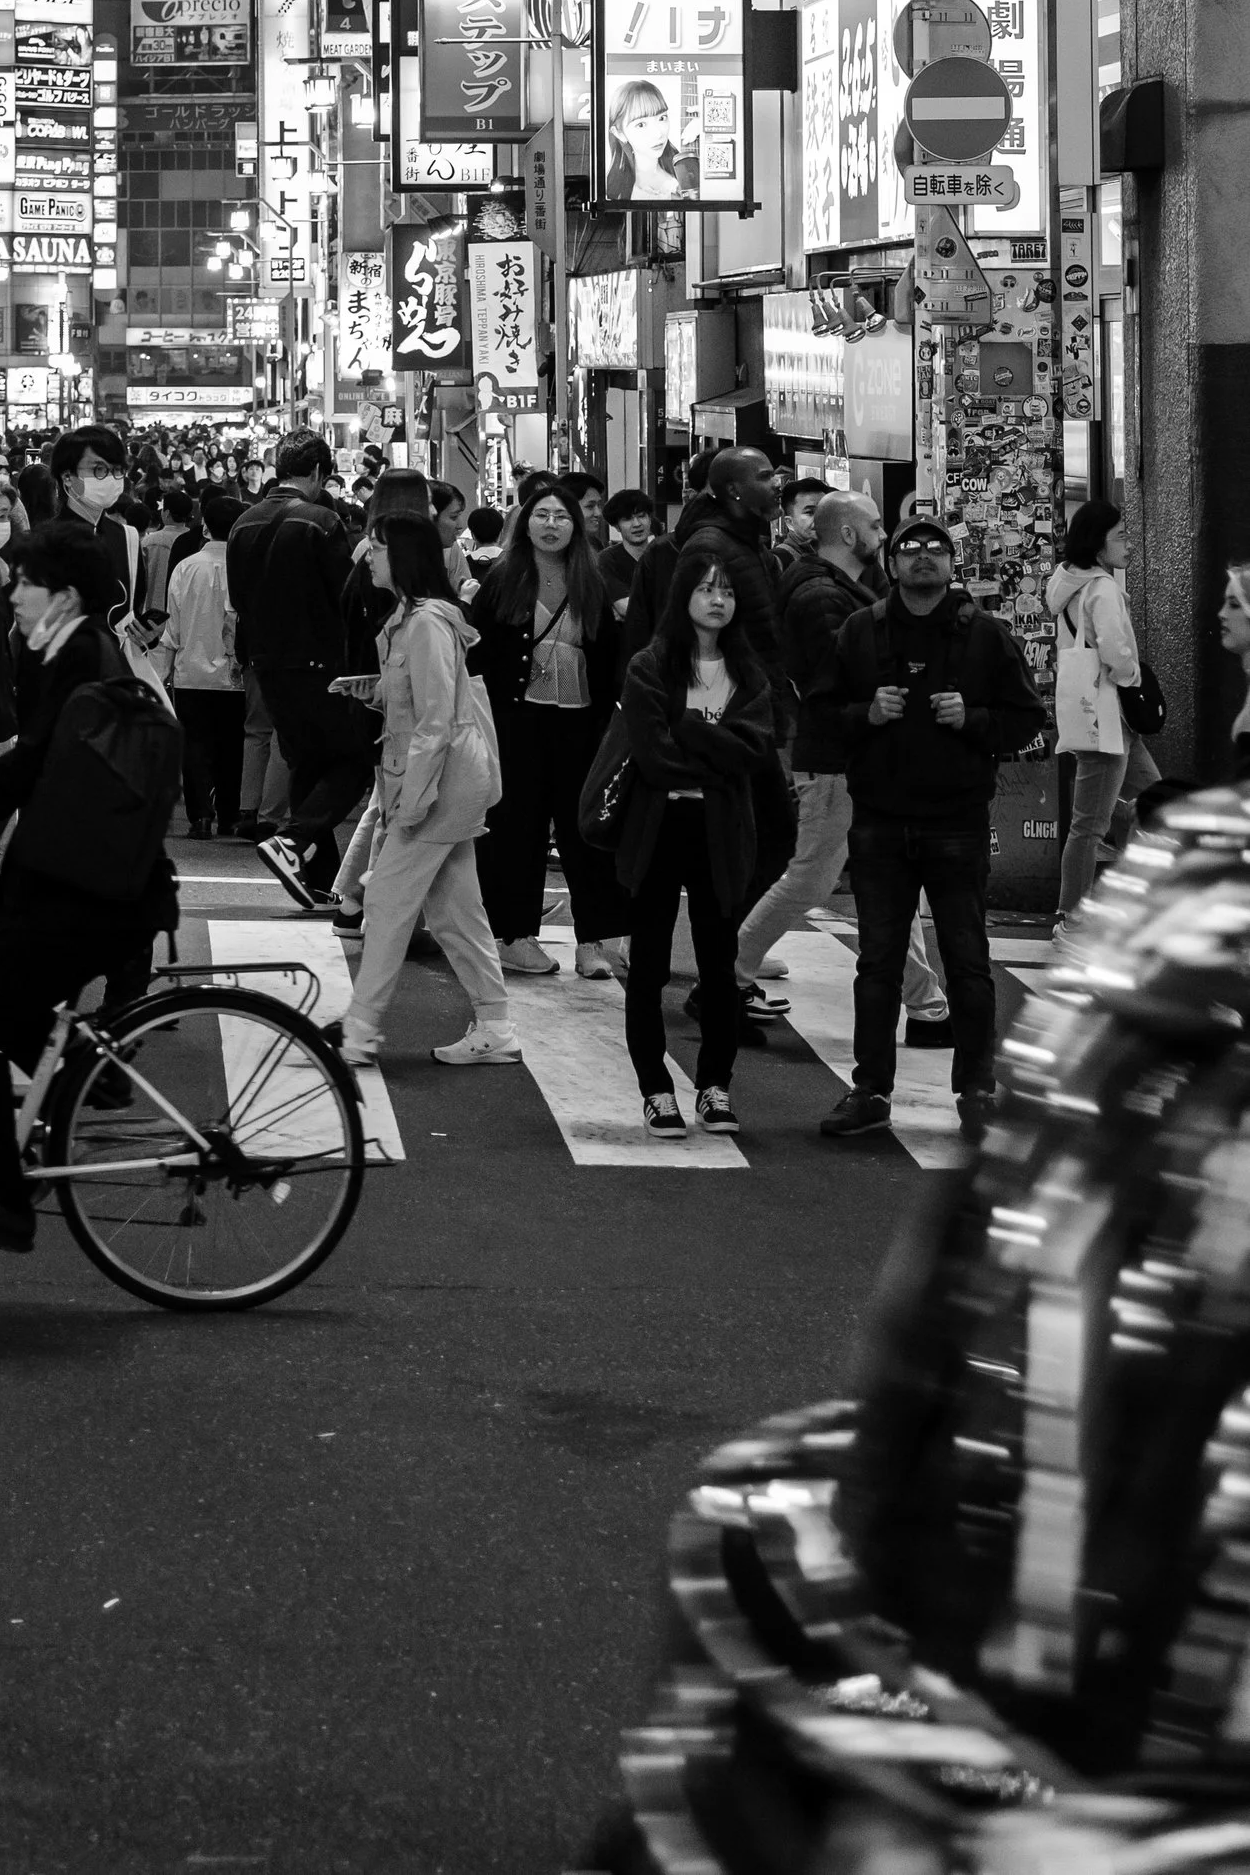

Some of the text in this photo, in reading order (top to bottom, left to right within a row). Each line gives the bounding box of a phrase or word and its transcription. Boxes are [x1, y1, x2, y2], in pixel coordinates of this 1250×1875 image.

[323, 44, 342, 56] MEAT
[646, 60, 700, 74] まいまい
[475, 118, 494, 130] B1
[460, 168, 491, 182] B1F
[533, 149, 547, 231] 劇場通り一番街
[913, 174, 1006, 198] 自転車を除く
[20, 197, 75, 217] GAME PANIC
[12, 236, 93, 264] SAUNA
[475, 254, 490, 365] HIROSHIMA TEPPANYAKI
[492, 252, 533, 374] お好み焼き
[506, 394, 538, 409] B1F
[961, 478, 988, 492] COW
